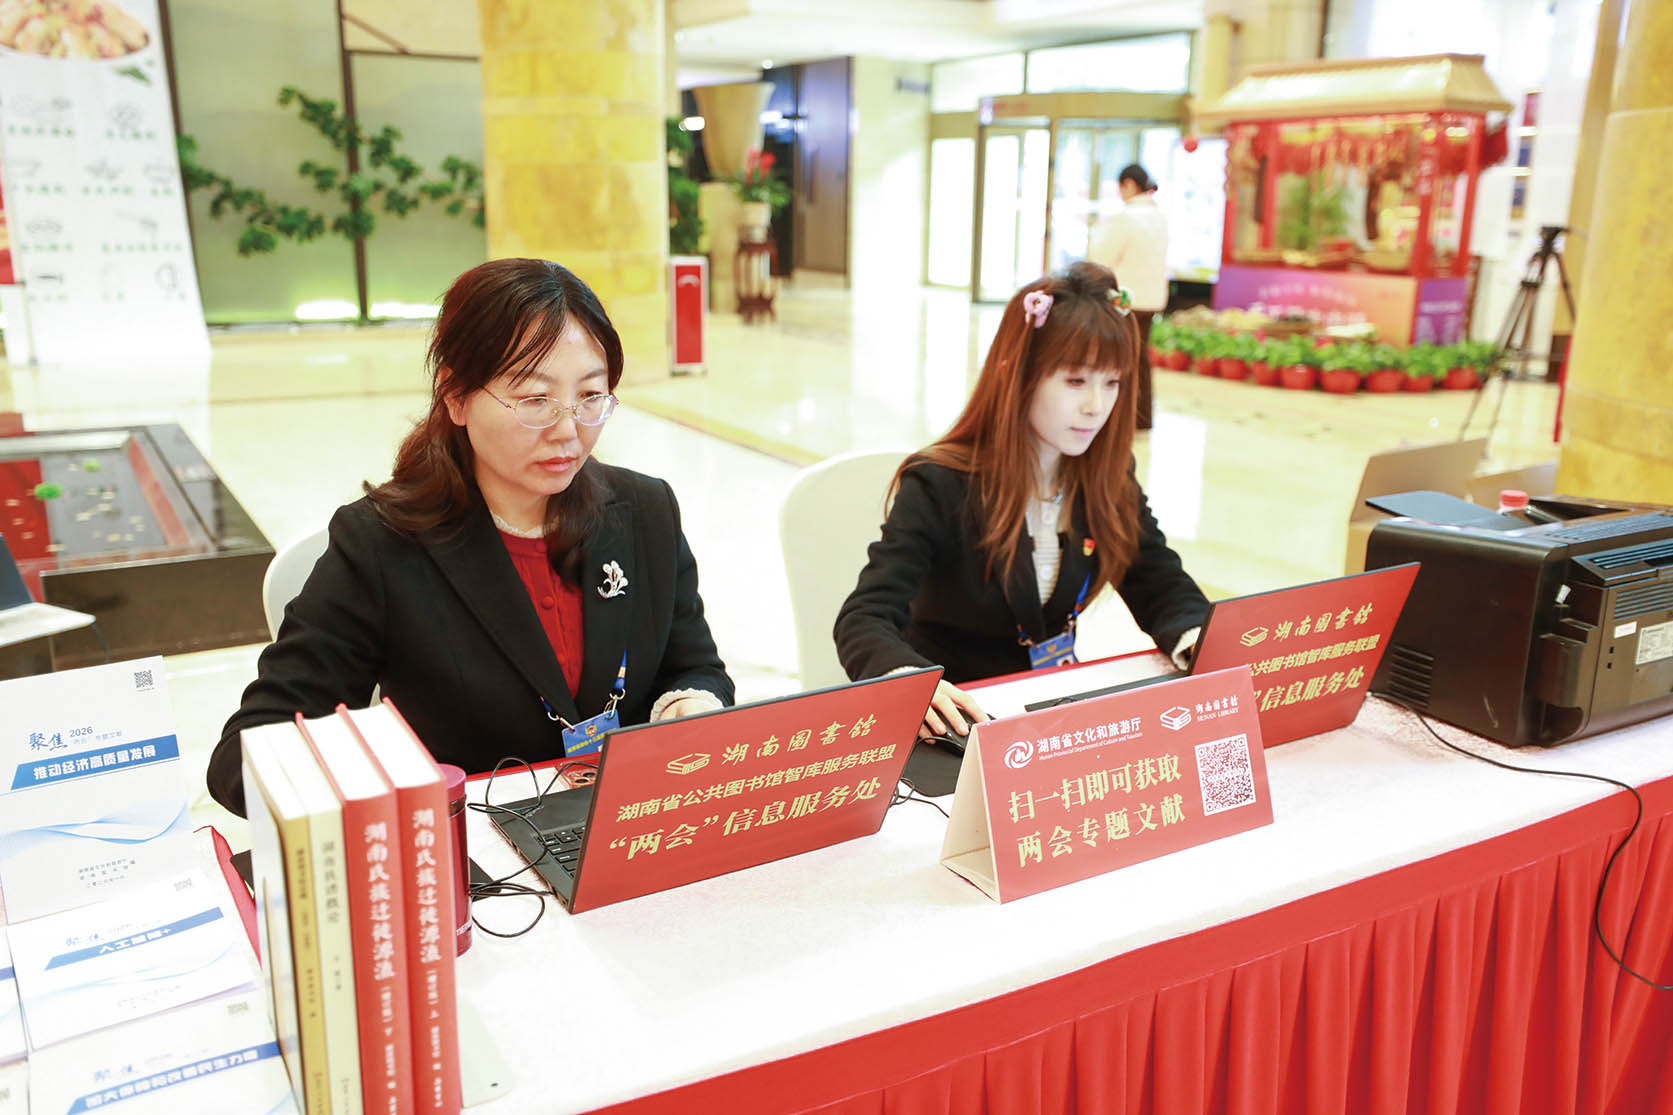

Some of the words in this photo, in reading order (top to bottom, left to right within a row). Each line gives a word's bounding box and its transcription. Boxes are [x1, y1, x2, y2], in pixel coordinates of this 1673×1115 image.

[33, 744, 156, 780] 推动经济高质量发展
[69, 726, 93, 737] 2026
[1037, 717, 1142, 754] 湖南省文化和旅游厅
[616, 743, 897, 822] 湖南省公共图书馆智库服务联盟
[1008, 753, 1182, 823] 扫一扫即可获取
[609, 776, 881, 860] “两会”信息服务处
[1016, 794, 1186, 868] 两会专题文献
